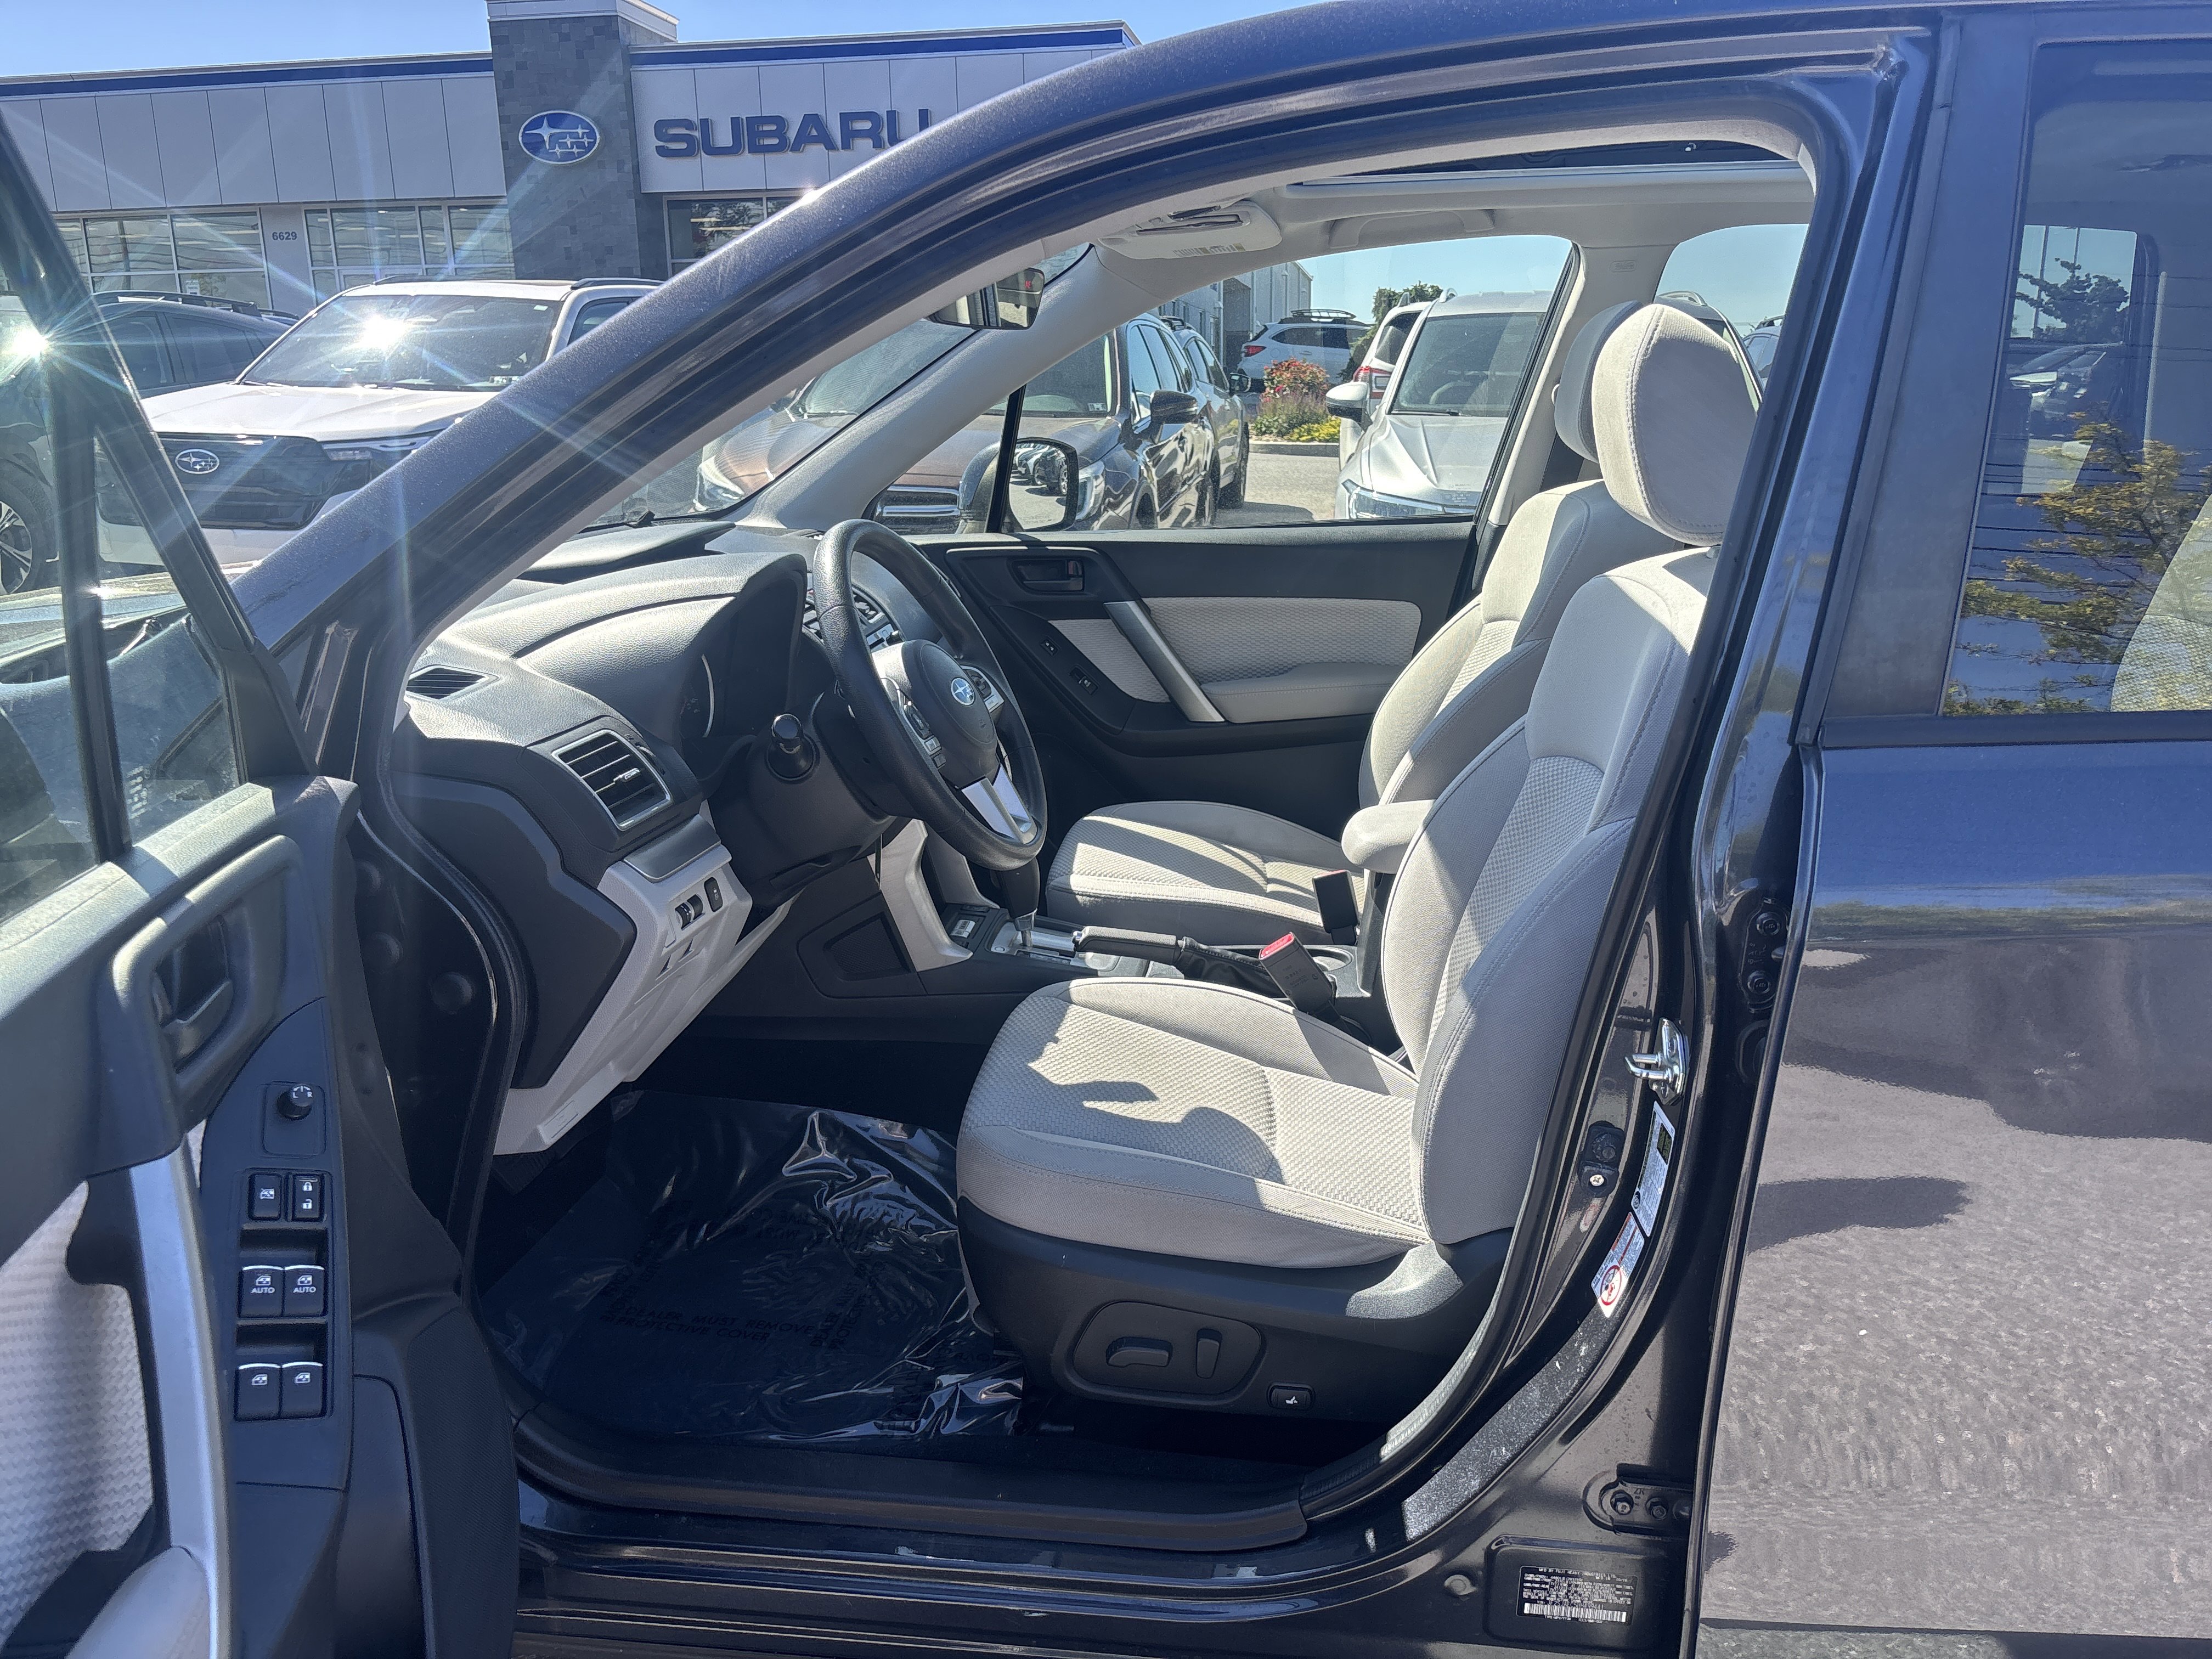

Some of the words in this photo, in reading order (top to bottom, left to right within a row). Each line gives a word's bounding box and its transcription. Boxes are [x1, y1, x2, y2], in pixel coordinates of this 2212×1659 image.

[654, 108, 929, 157] SUBARU
[272, 232, 297, 240] 6629
[615, 1317, 708, 1335] PROTECTIVE
[716, 1328, 772, 1342] COVER
[624, 1307, 684, 1322] DEALER
[691, 1316, 738, 1326] MUST
[746, 1319, 817, 1335] REMOVE
